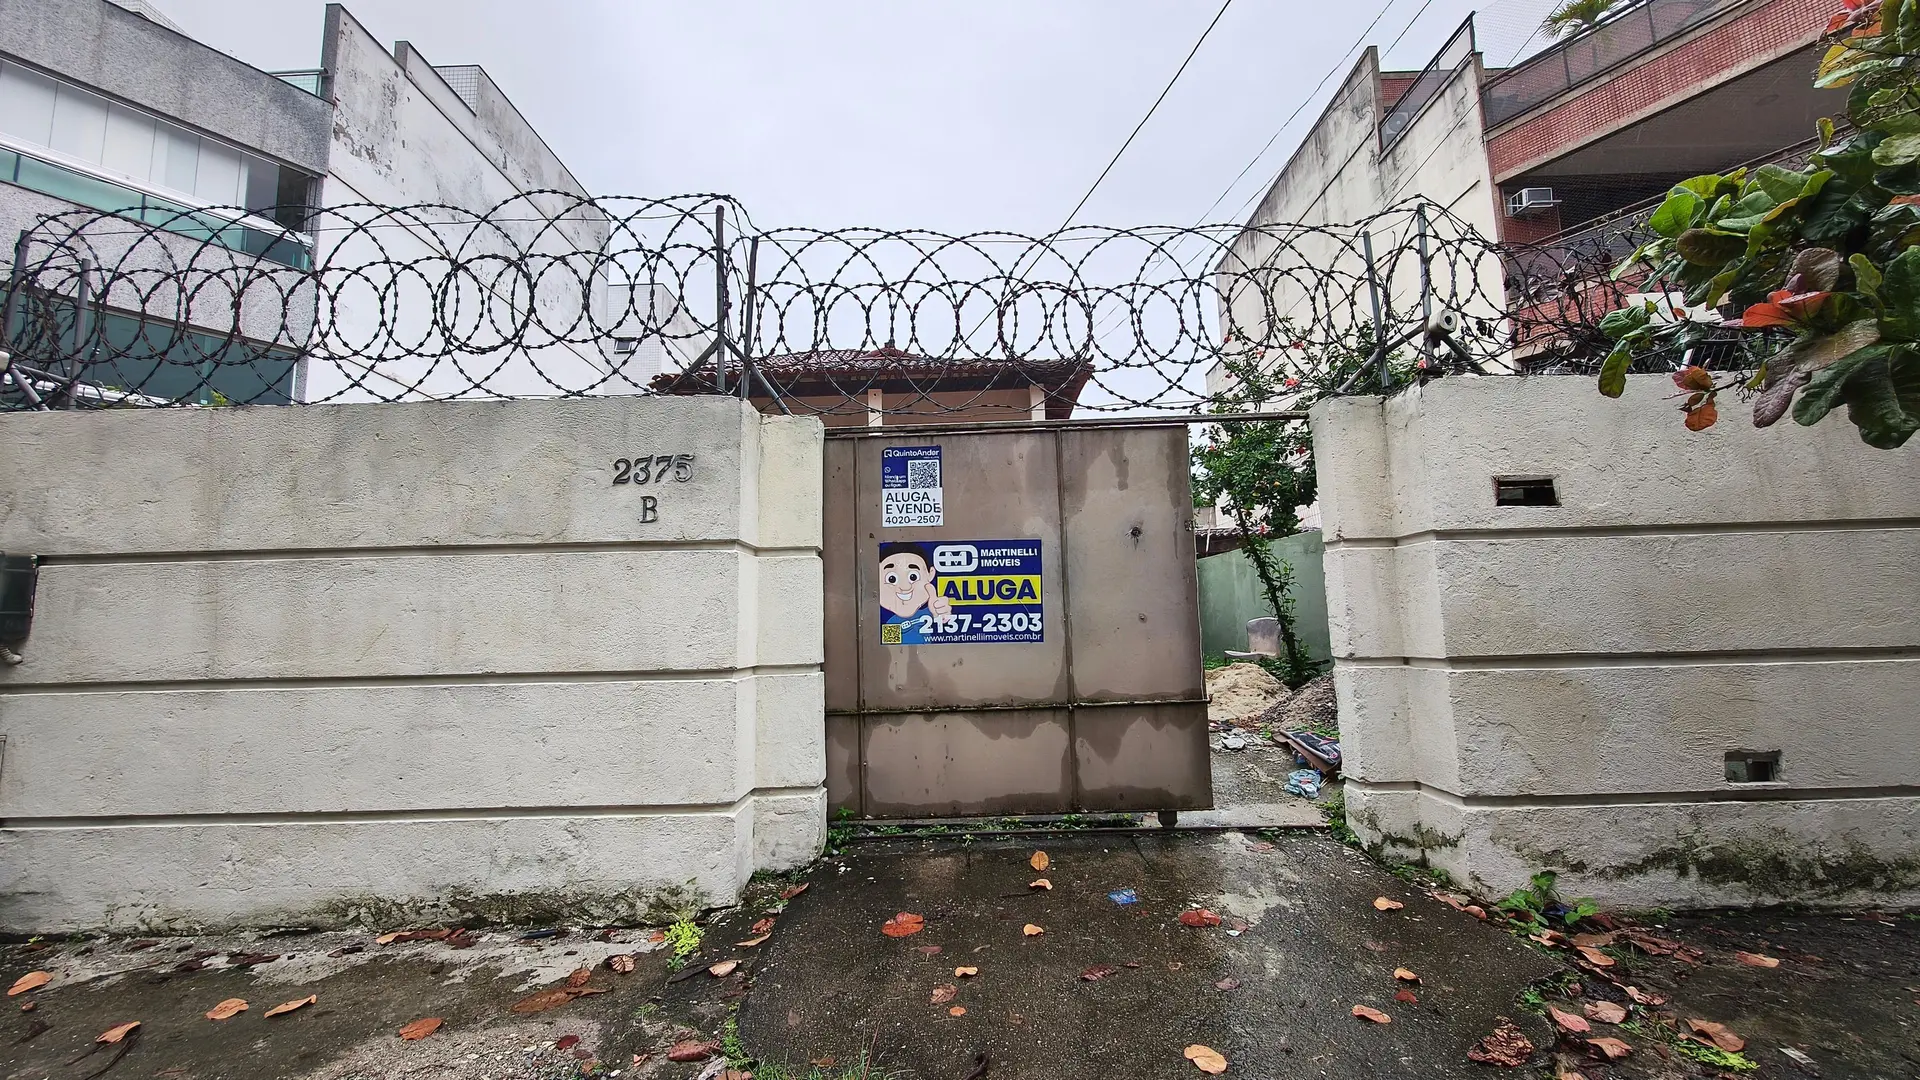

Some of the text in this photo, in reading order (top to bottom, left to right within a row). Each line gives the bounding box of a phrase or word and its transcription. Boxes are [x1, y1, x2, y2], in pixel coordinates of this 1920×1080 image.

[612, 454, 695, 486] 2375
[639, 495, 658, 523] B
[886, 503, 941, 514] E VENDE
[885, 515, 941, 524] 4020-2507
[980, 548, 1038, 557] MARTINELLI
[980, 557, 1021, 567] IMÓVEIS
[943, 579, 1038, 601] ALUGA
[919, 612, 1043, 634] 2137-2303
[923, 632, 1042, 643] www.martinelliimoveis.com.br
